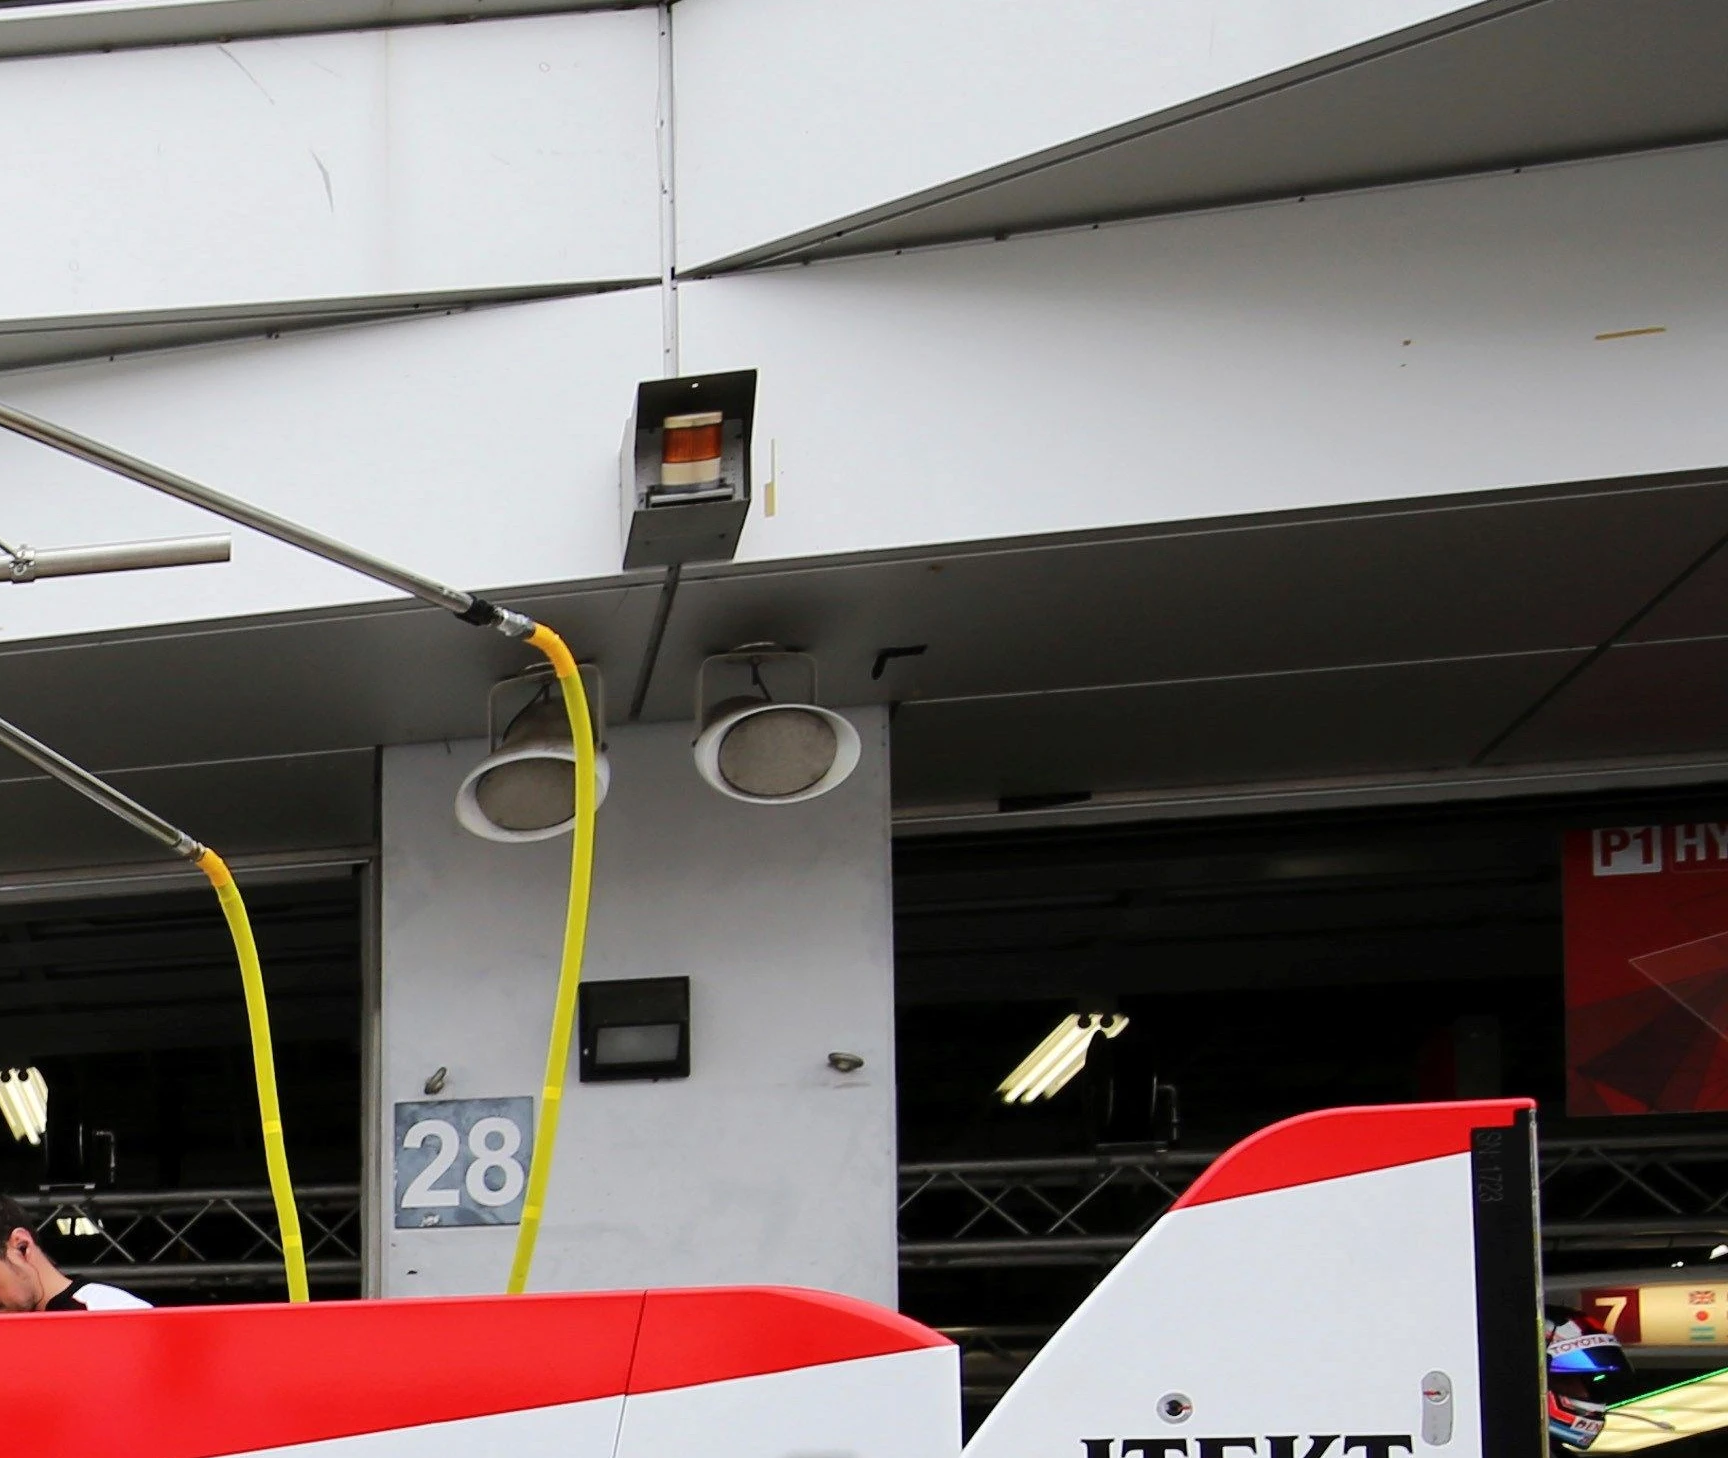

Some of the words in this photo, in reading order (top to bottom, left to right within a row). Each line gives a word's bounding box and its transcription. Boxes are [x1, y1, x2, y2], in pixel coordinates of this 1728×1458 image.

[1600, 827, 1654, 867] P1
[400, 1116, 526, 1210] 28
[1595, 1297, 1628, 1335] 7
